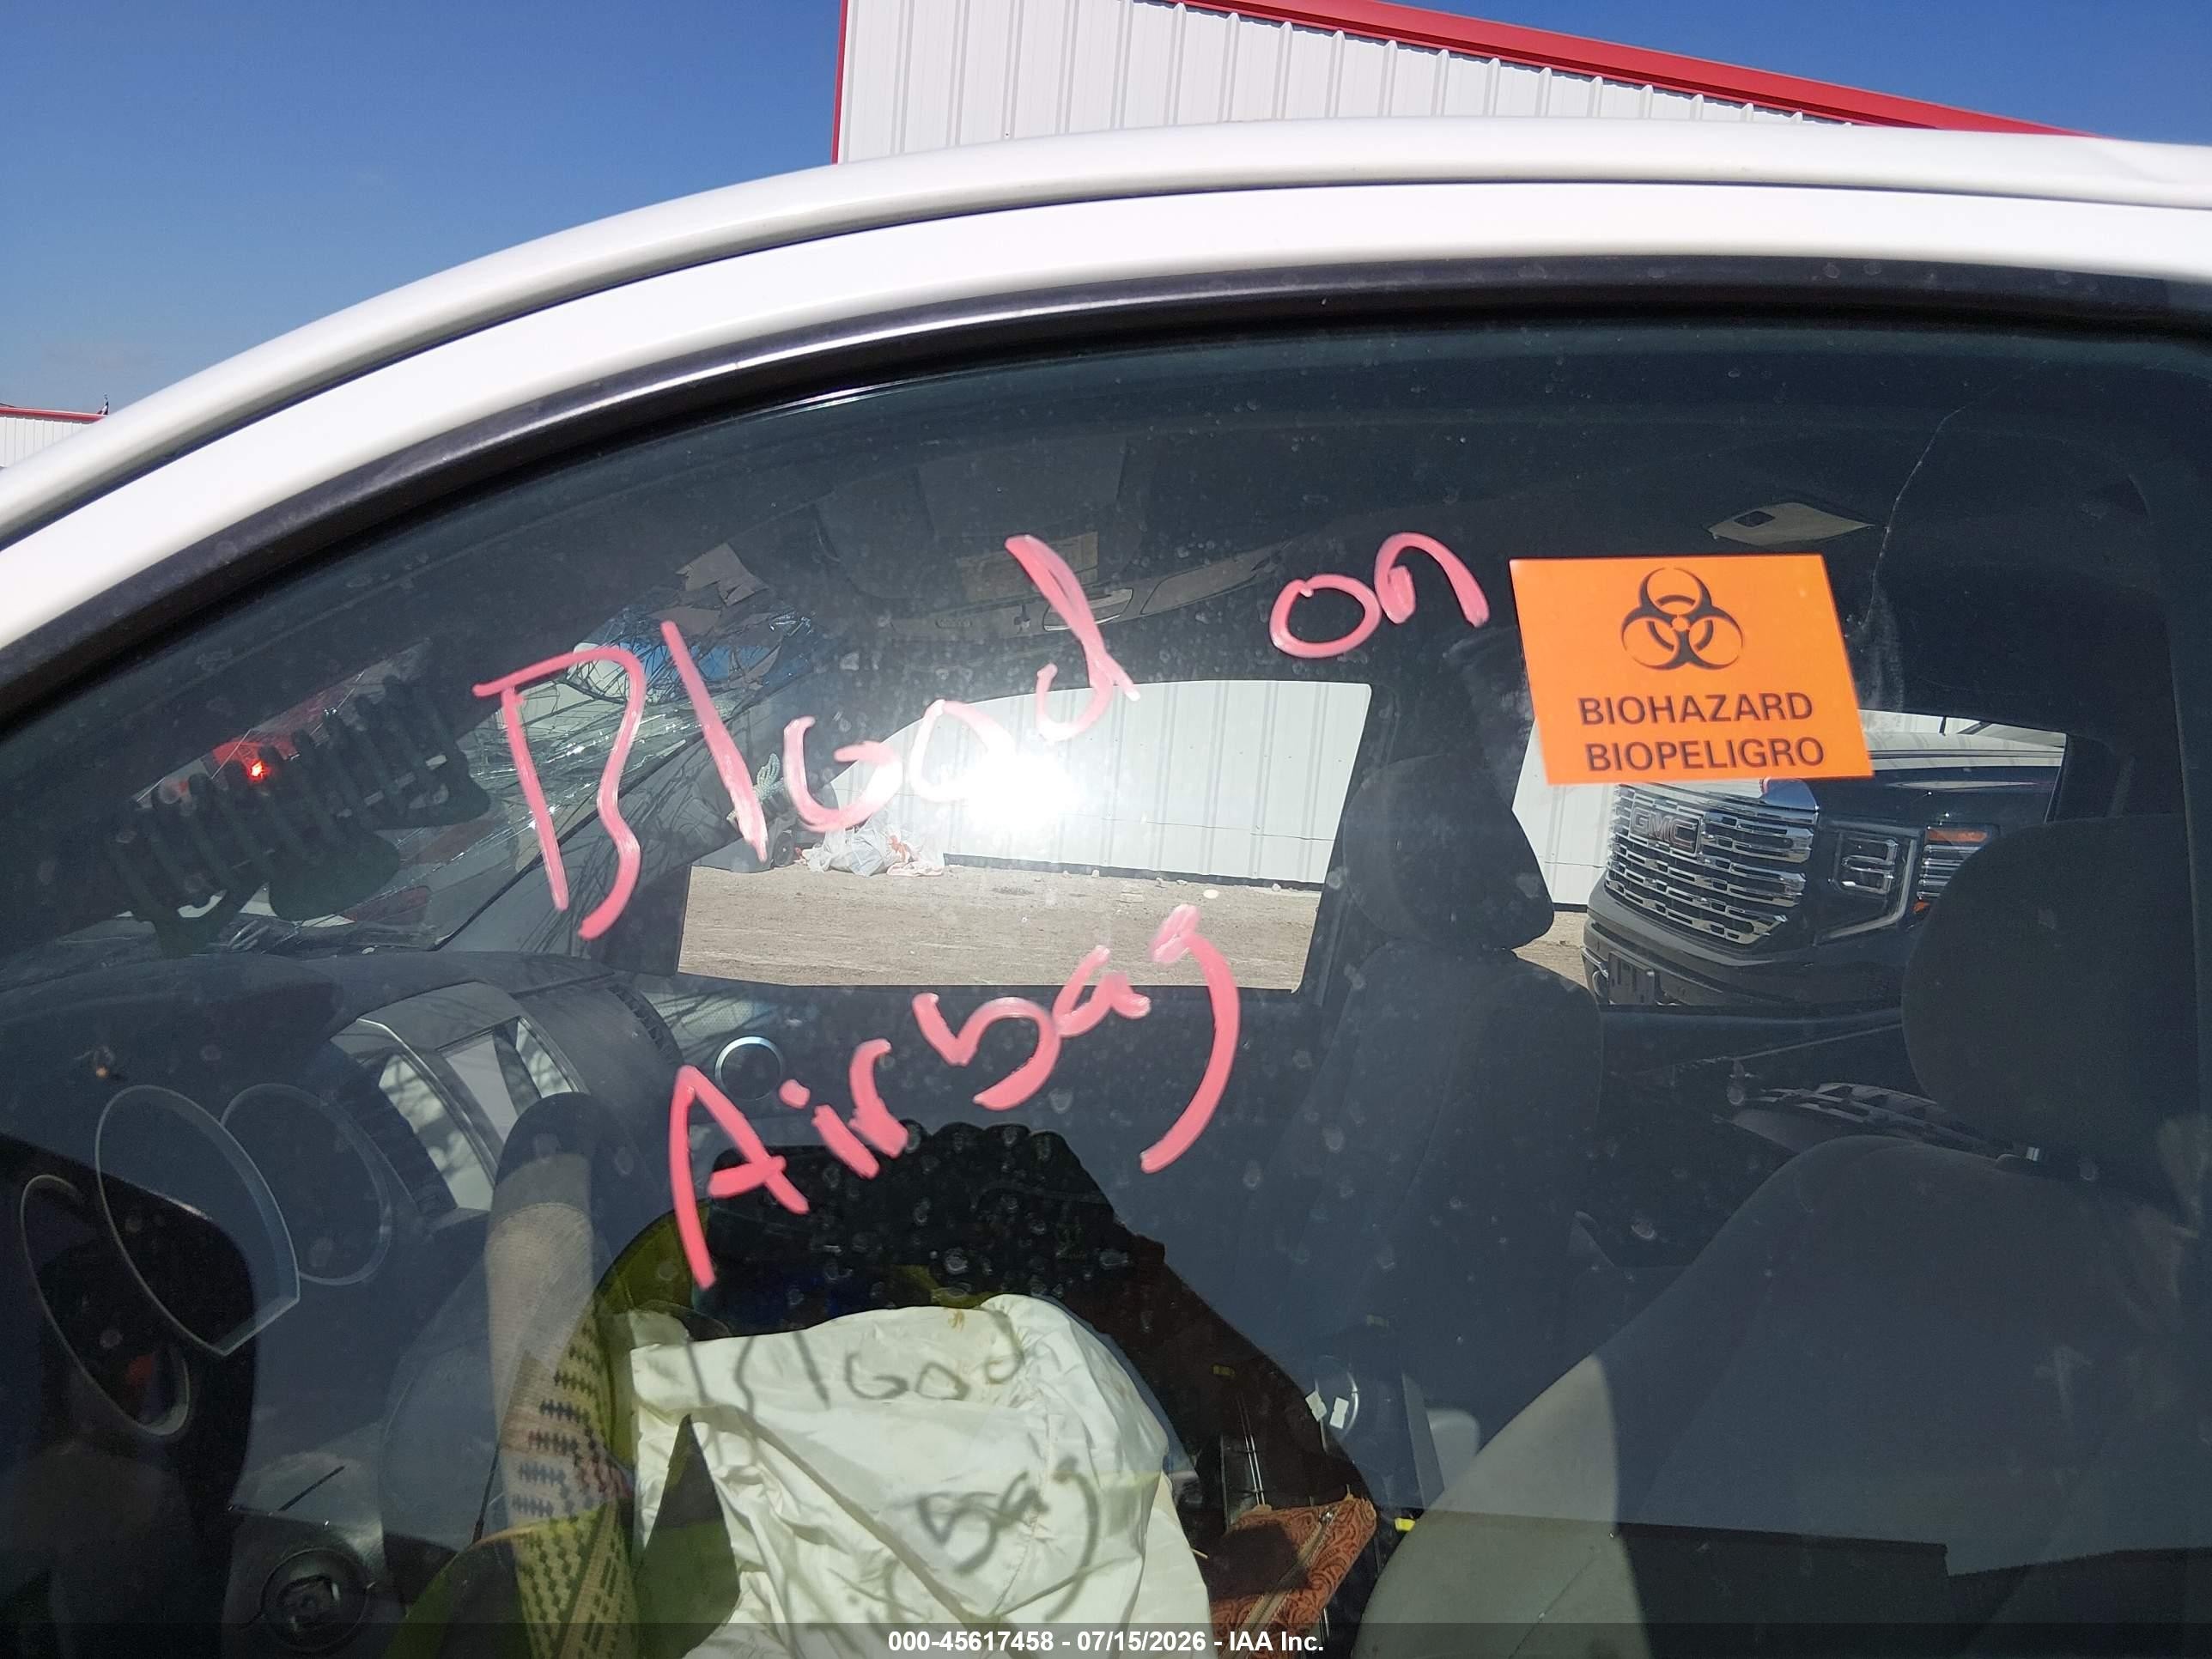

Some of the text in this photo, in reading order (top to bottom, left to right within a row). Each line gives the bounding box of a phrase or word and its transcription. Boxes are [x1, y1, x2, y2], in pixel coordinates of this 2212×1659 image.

[1269, 532, 1490, 659] on
[1578, 691, 1814, 726] BIOHAZARD
[1585, 736, 1825, 772] BIOPELIGRO
[1631, 805, 1698, 850] GMC
